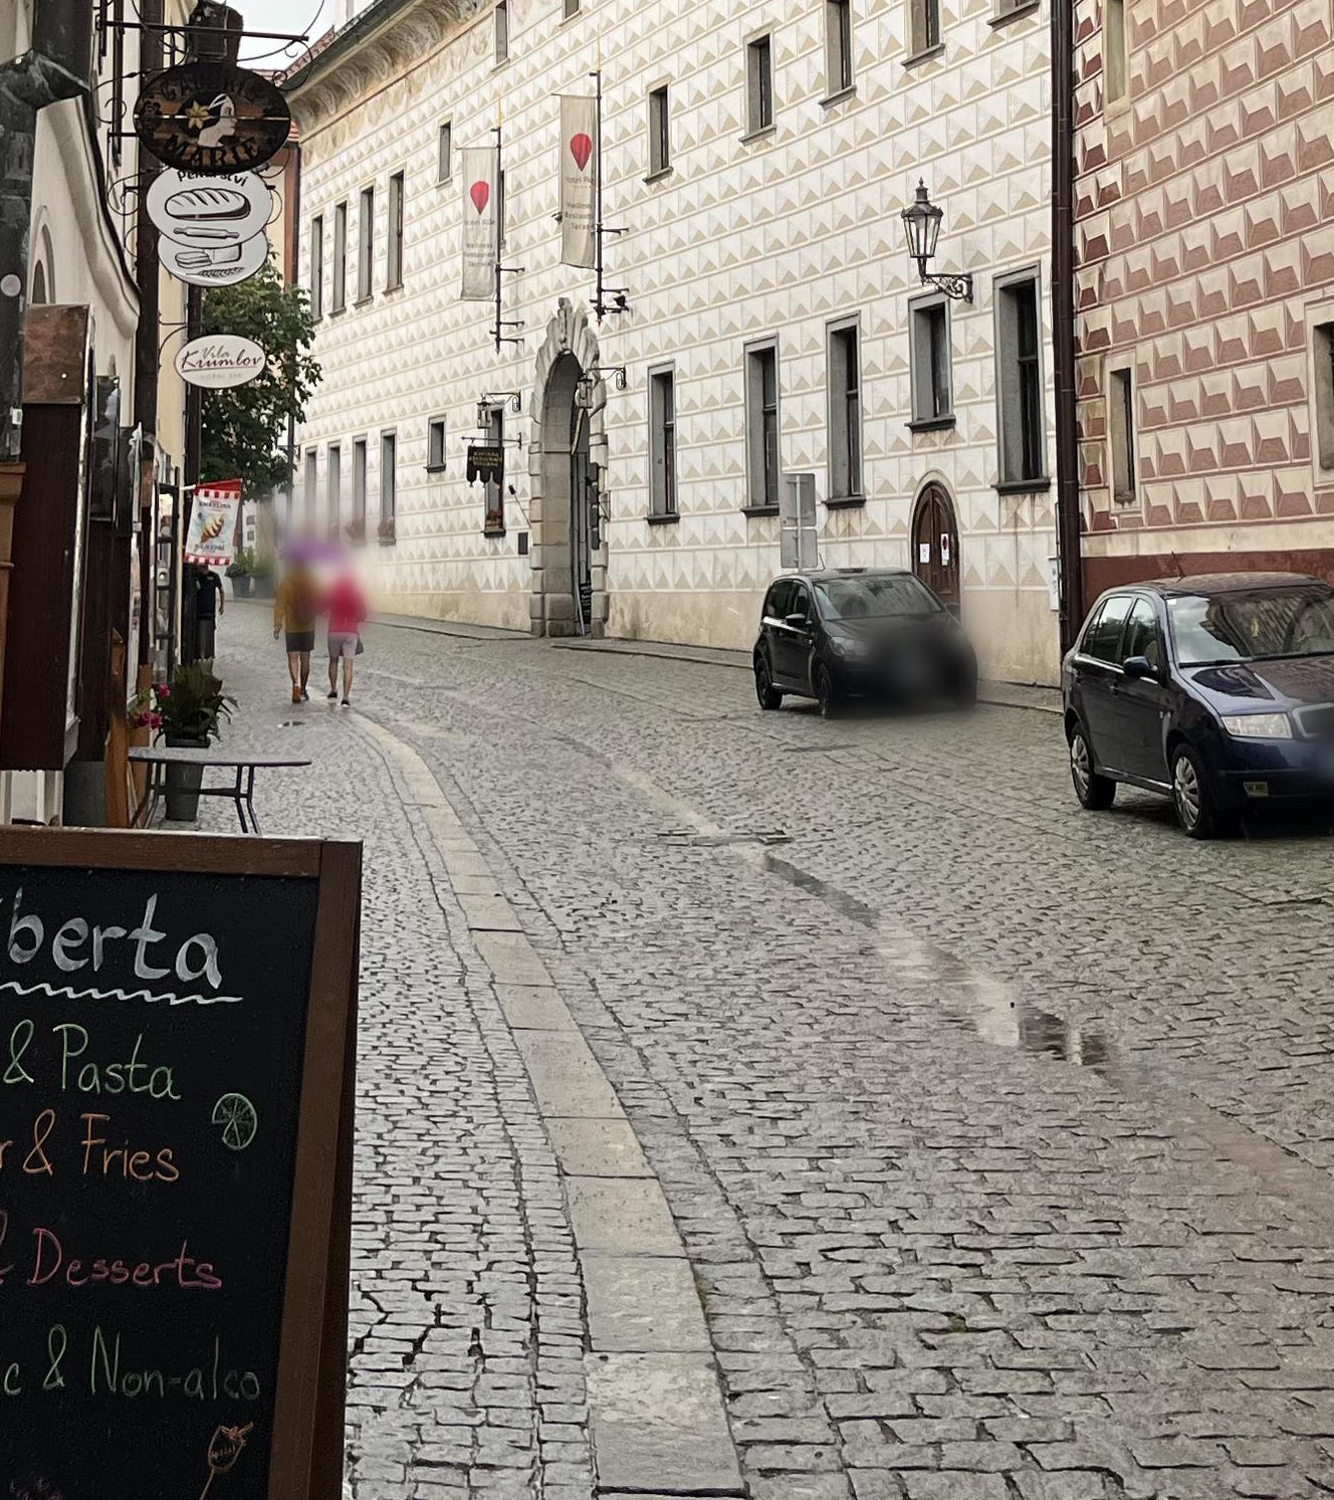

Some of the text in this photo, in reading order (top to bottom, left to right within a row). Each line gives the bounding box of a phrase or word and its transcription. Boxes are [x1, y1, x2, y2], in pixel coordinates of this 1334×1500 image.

[181, 349, 263, 370] Krumlov
[4, 1019, 36, 1084] &
[53, 1022, 183, 1102] Pasta
[22, 1107, 55, 1177] &
[80, 1112, 180, 1185] Fries
[26, 1225, 223, 1290] Desserts
[43, 1322, 67, 1391] &
[89, 1324, 261, 1400] Non-alco
